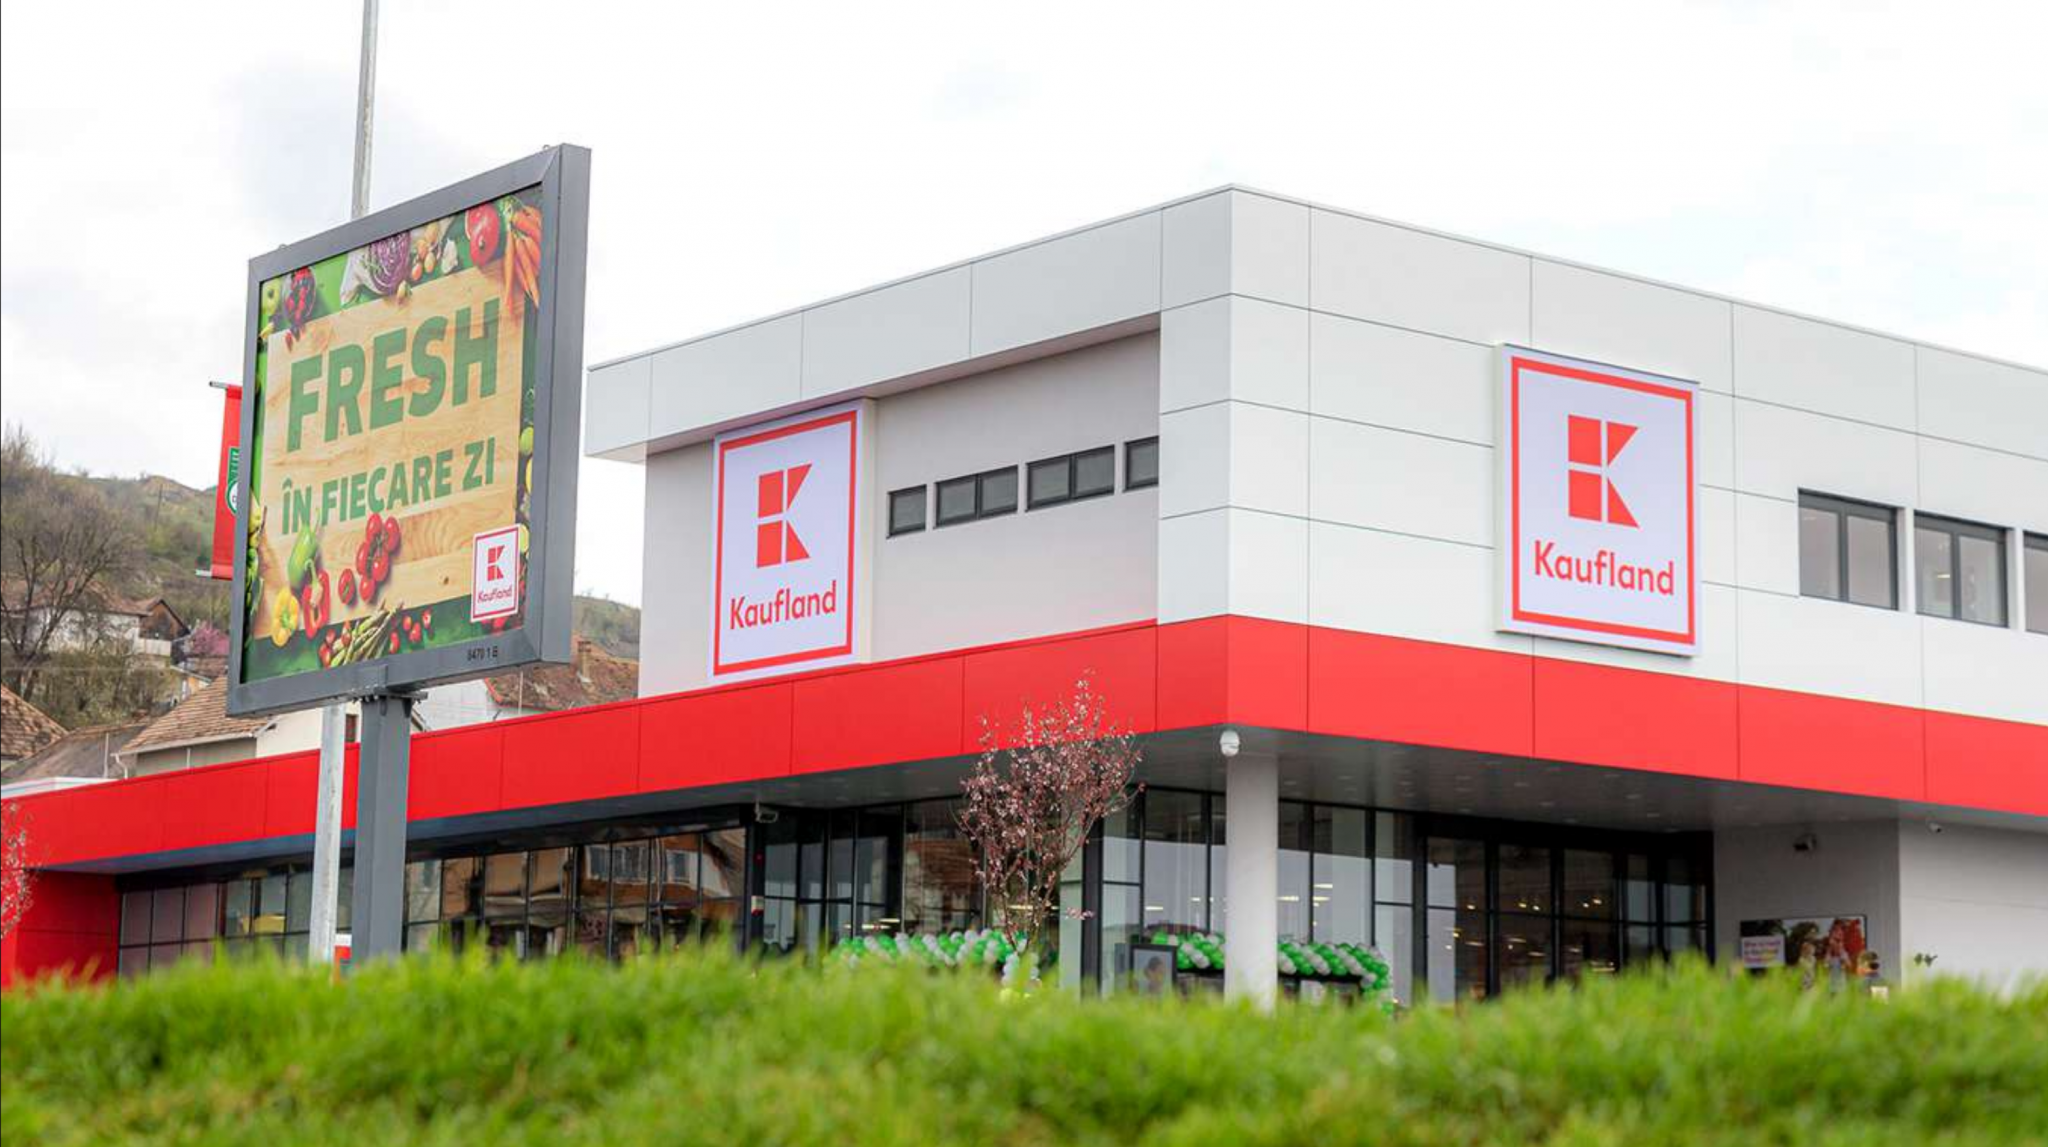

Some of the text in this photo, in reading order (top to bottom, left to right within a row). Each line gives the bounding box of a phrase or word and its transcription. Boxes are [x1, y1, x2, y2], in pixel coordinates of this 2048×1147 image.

[287, 297, 500, 452] FRESH
[282, 478, 312, 534] ÎN
[321, 449, 453, 527] FIECARE
[463, 436, 495, 491] ZI
[478, 584, 512, 603] Kaufland
[1534, 539, 1674, 595] Kaufland
[729, 579, 837, 630] Kaufland
